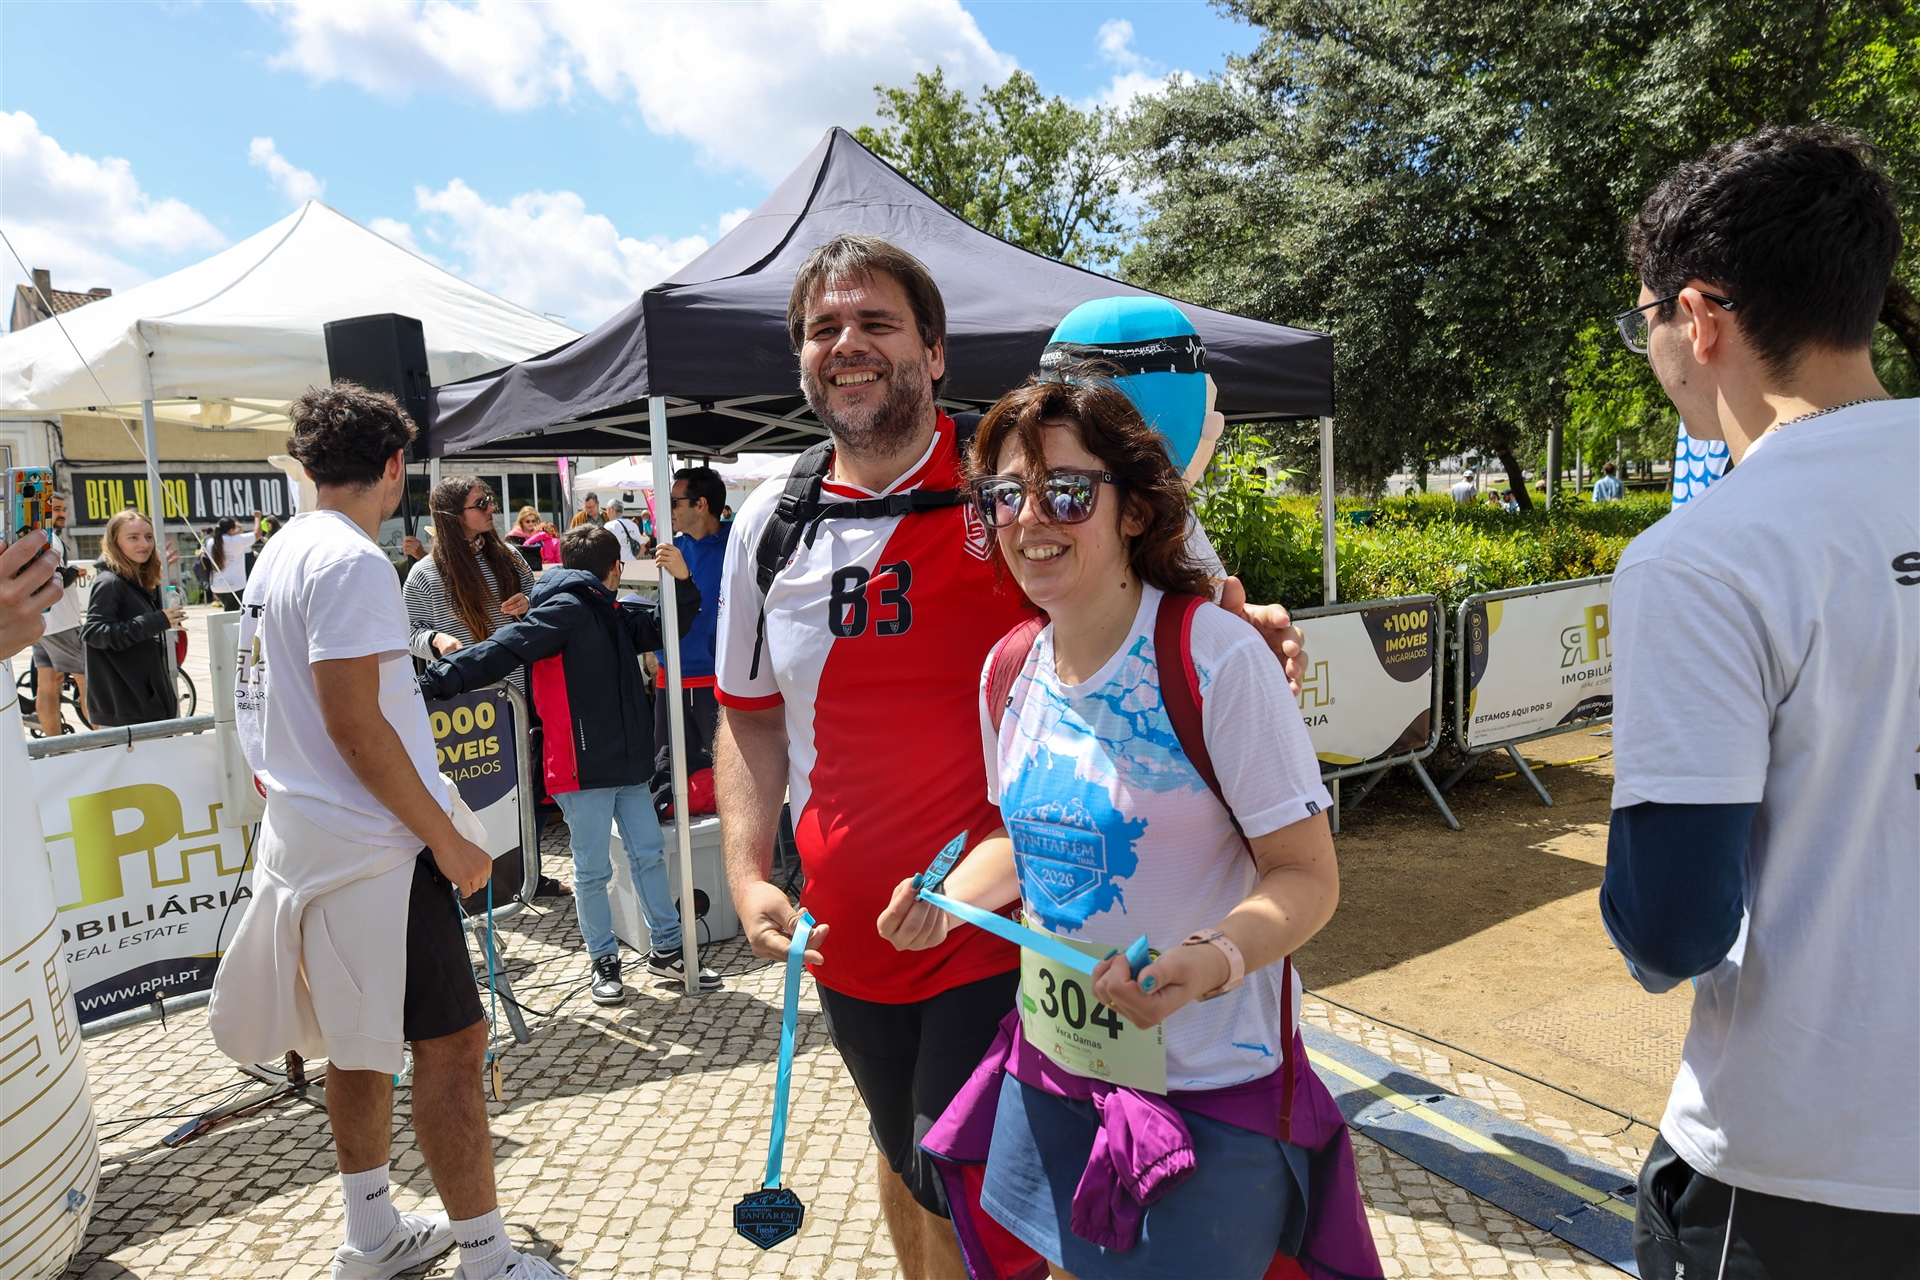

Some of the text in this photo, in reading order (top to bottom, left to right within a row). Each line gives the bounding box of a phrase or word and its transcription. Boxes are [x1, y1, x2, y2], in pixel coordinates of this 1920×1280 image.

[85, 479, 189, 520] BEM-VIDO
[195, 473, 206, 517] À
[210, 478, 254, 517] CASA
[260, 478, 281, 516] DO
[828, 560, 913, 638] 83
[1384, 609, 1428, 632] +1000
[1385, 632, 1428, 652] IMÓVEIS
[1385, 648, 1427, 665] ANGARIADOS
[1475, 711, 1510, 724] ESTAMOS
[1511, 707, 1529, 717] AQUI
[1530, 703, 1544, 713] POR
[1015, 831, 1095, 858] SANTARÉM
[1077, 857, 1097, 866] TRAIL
[1041, 868, 1075, 888] 2026
[118, 922, 190, 950] ESTATE
[80, 969, 200, 1012] WWW.RPH.PT
[1039, 968, 1123, 1039] 304
[1055, 1024, 1102, 1049] Vera Damas
[740, 1209, 794, 1219] SANTARÉM
